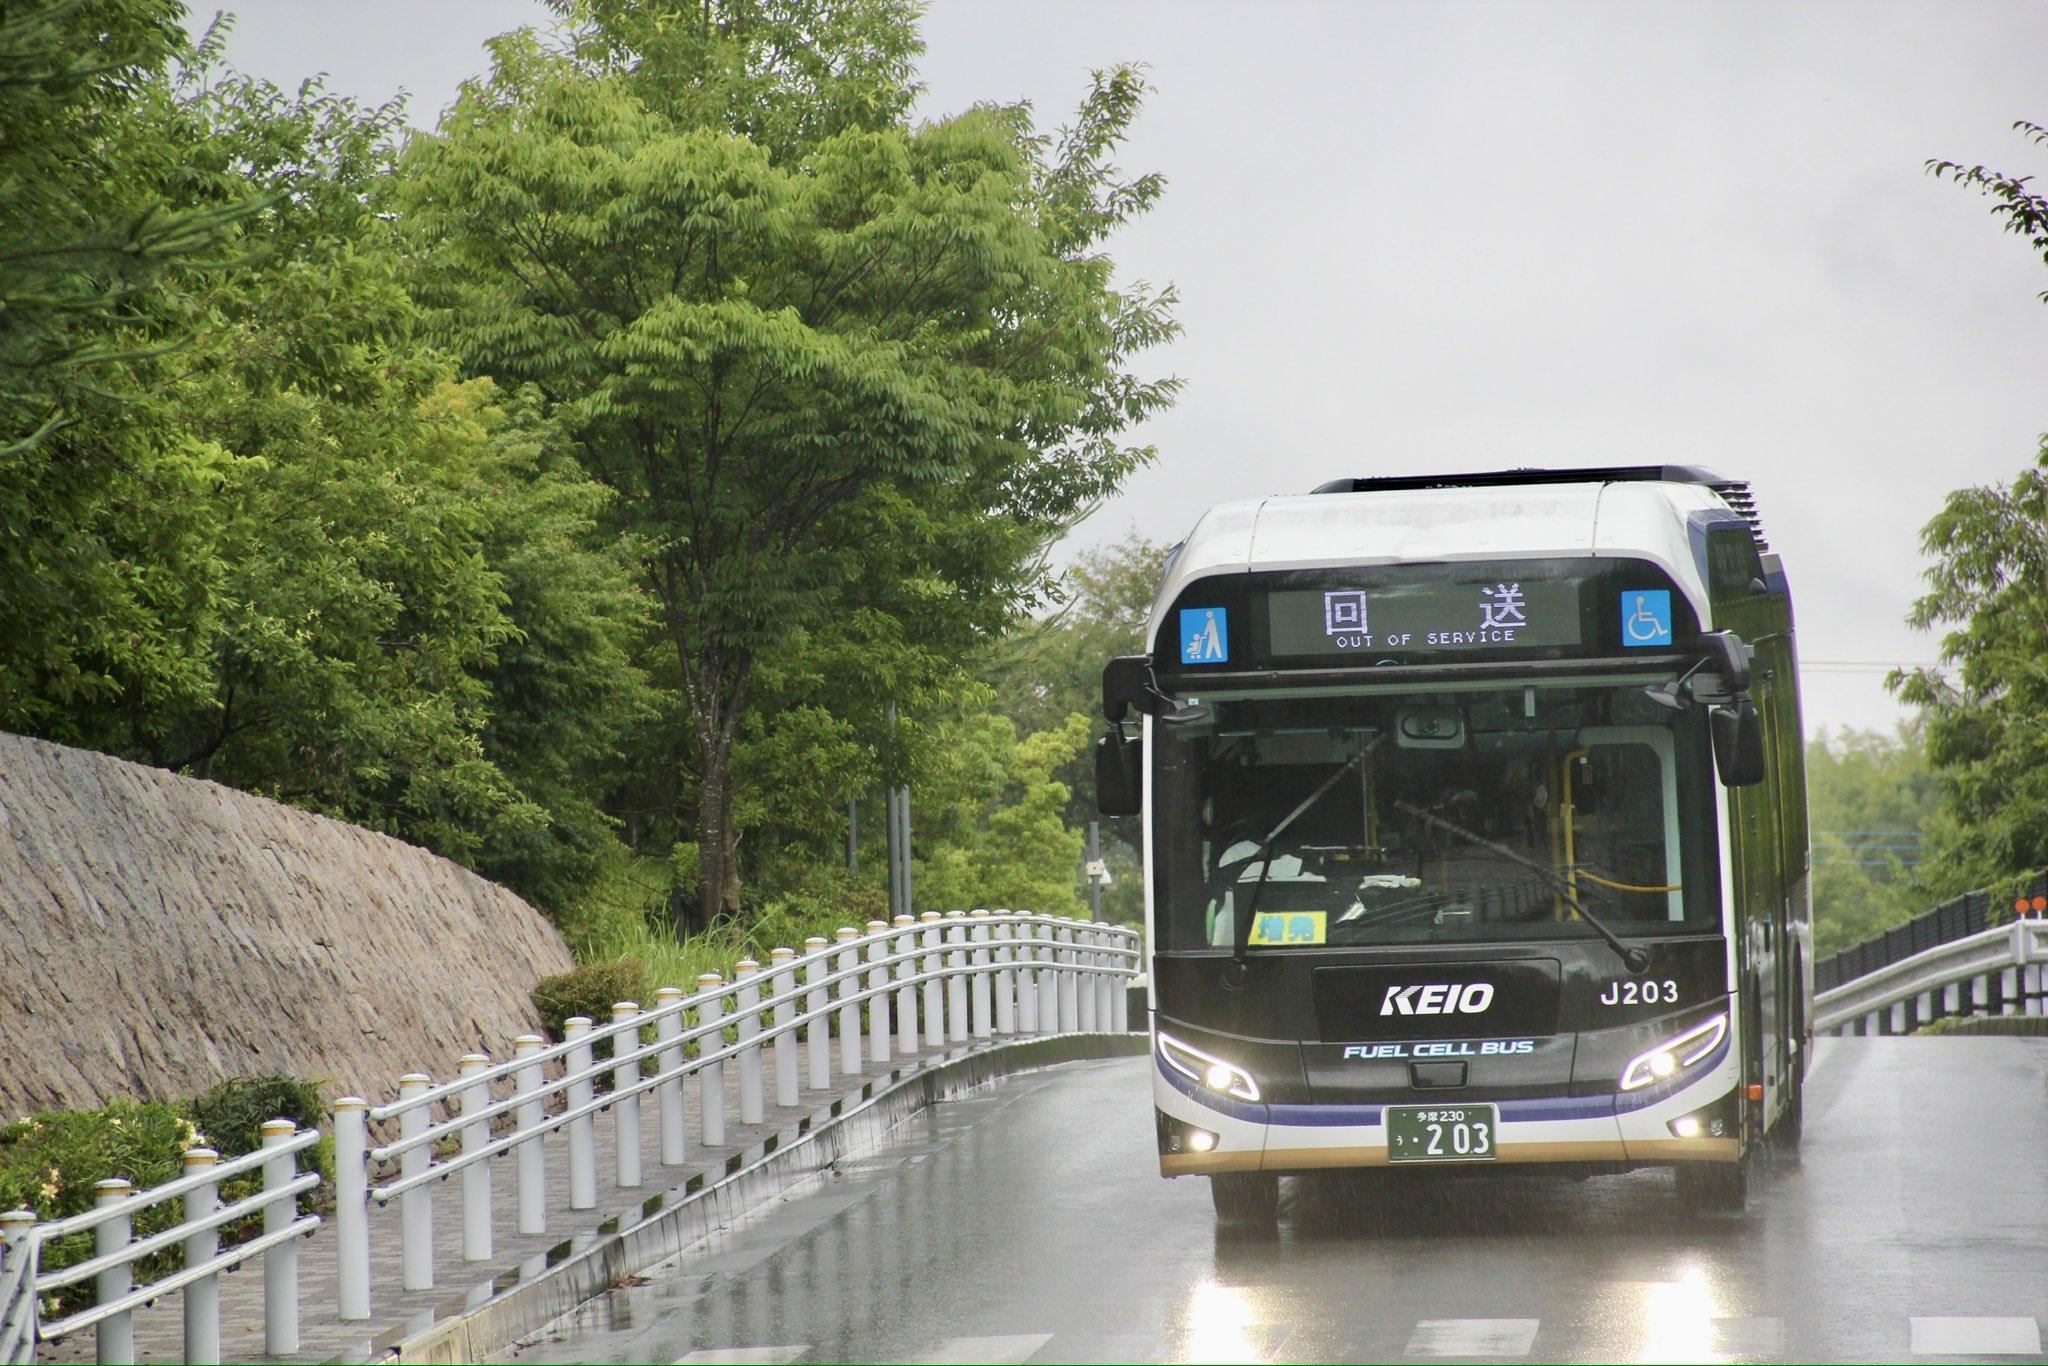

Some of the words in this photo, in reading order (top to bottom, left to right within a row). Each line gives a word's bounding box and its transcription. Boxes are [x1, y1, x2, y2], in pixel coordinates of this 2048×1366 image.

[1336, 636, 1373, 647] OUT
[1387, 634, 1411, 646] OF
[1427, 630, 1515, 645] SERVICE
[1379, 983, 1494, 1016] KEIO
[1600, 980, 1679, 1006] J203
[1343, 1045, 1408, 1059] FUEL
[1413, 1042, 1475, 1057] CELL
[1480, 1040, 1534, 1055] BUS
